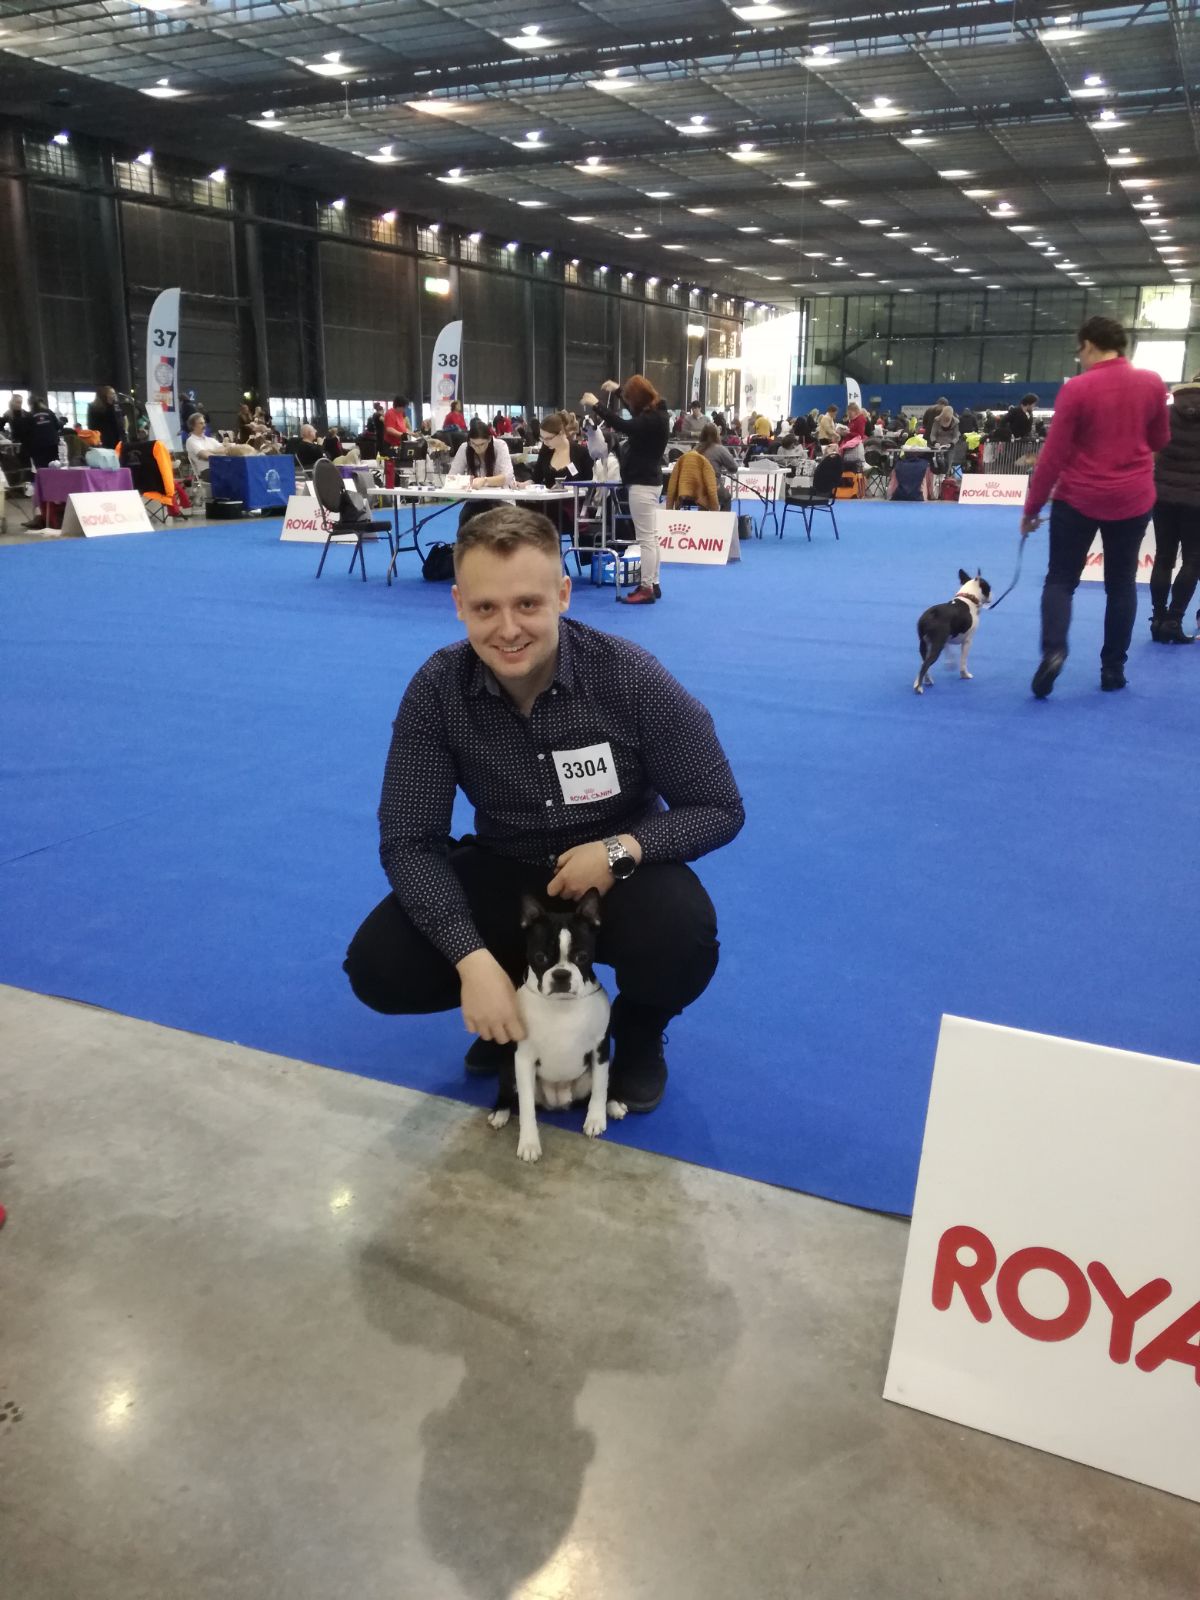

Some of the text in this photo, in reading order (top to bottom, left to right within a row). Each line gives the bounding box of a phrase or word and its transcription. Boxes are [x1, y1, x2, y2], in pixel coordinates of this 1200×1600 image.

[153, 328, 177, 349] 37
[438, 353, 458, 367] 38
[188, 390, 195, 401] 2
[962, 489, 1022, 498] ROYAL CANIN
[286, 518, 318, 531] ROYAL
[678, 537, 723, 551] CANIN
[562, 757, 607, 779] 3304
